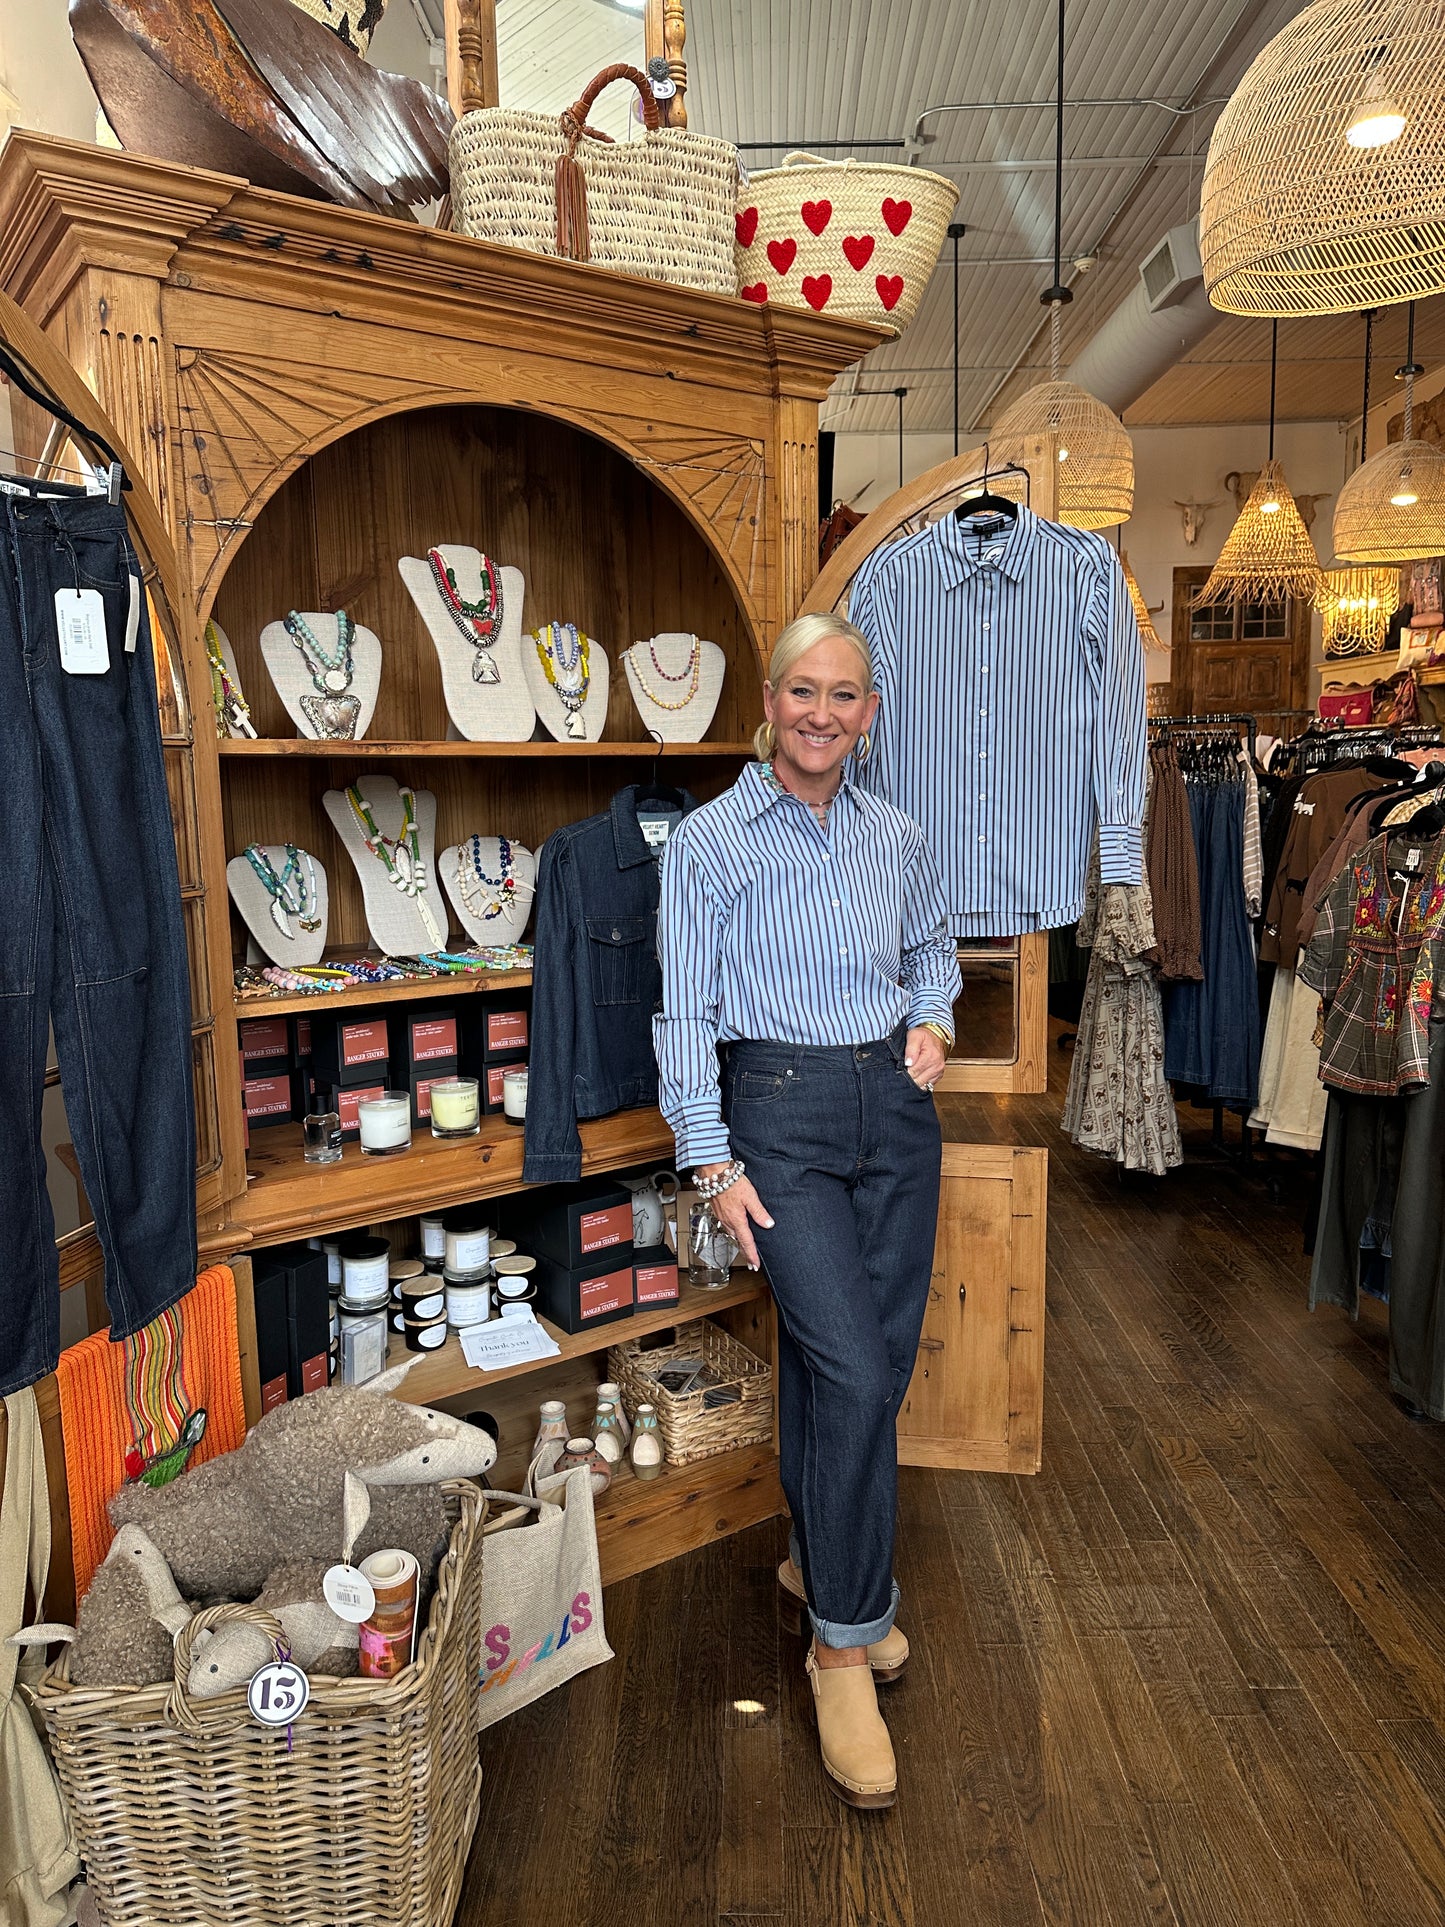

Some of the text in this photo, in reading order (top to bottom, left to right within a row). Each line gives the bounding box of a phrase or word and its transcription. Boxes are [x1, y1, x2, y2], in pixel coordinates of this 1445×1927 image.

[491, 1039, 508, 1048] RANGER
[508, 1036, 526, 1045] STATION
[244, 1048, 265, 1058] RANGER
[265, 1046, 287, 1055] STATION
[346, 1053, 366, 1063] RANGER
[366, 1050, 385, 1059] STATION
[416, 1050, 435, 1059] RANGER
[435, 1047, 454, 1056] STATION
[247, 1105, 268, 1115] RANGER
[268, 1103, 288, 1112] STATION
[342, 1119, 360, 1129] RANGE
[584, 1240, 602, 1250] RANGER
[602, 1235, 620, 1246] STATION
[640, 1292, 659, 1301] RANGER
[659, 1290, 676, 1299] STATION
[583, 1305, 601, 1316] RANGER
[601, 1300, 619, 1312] STATION
[260, 1677, 296, 1710] 15
